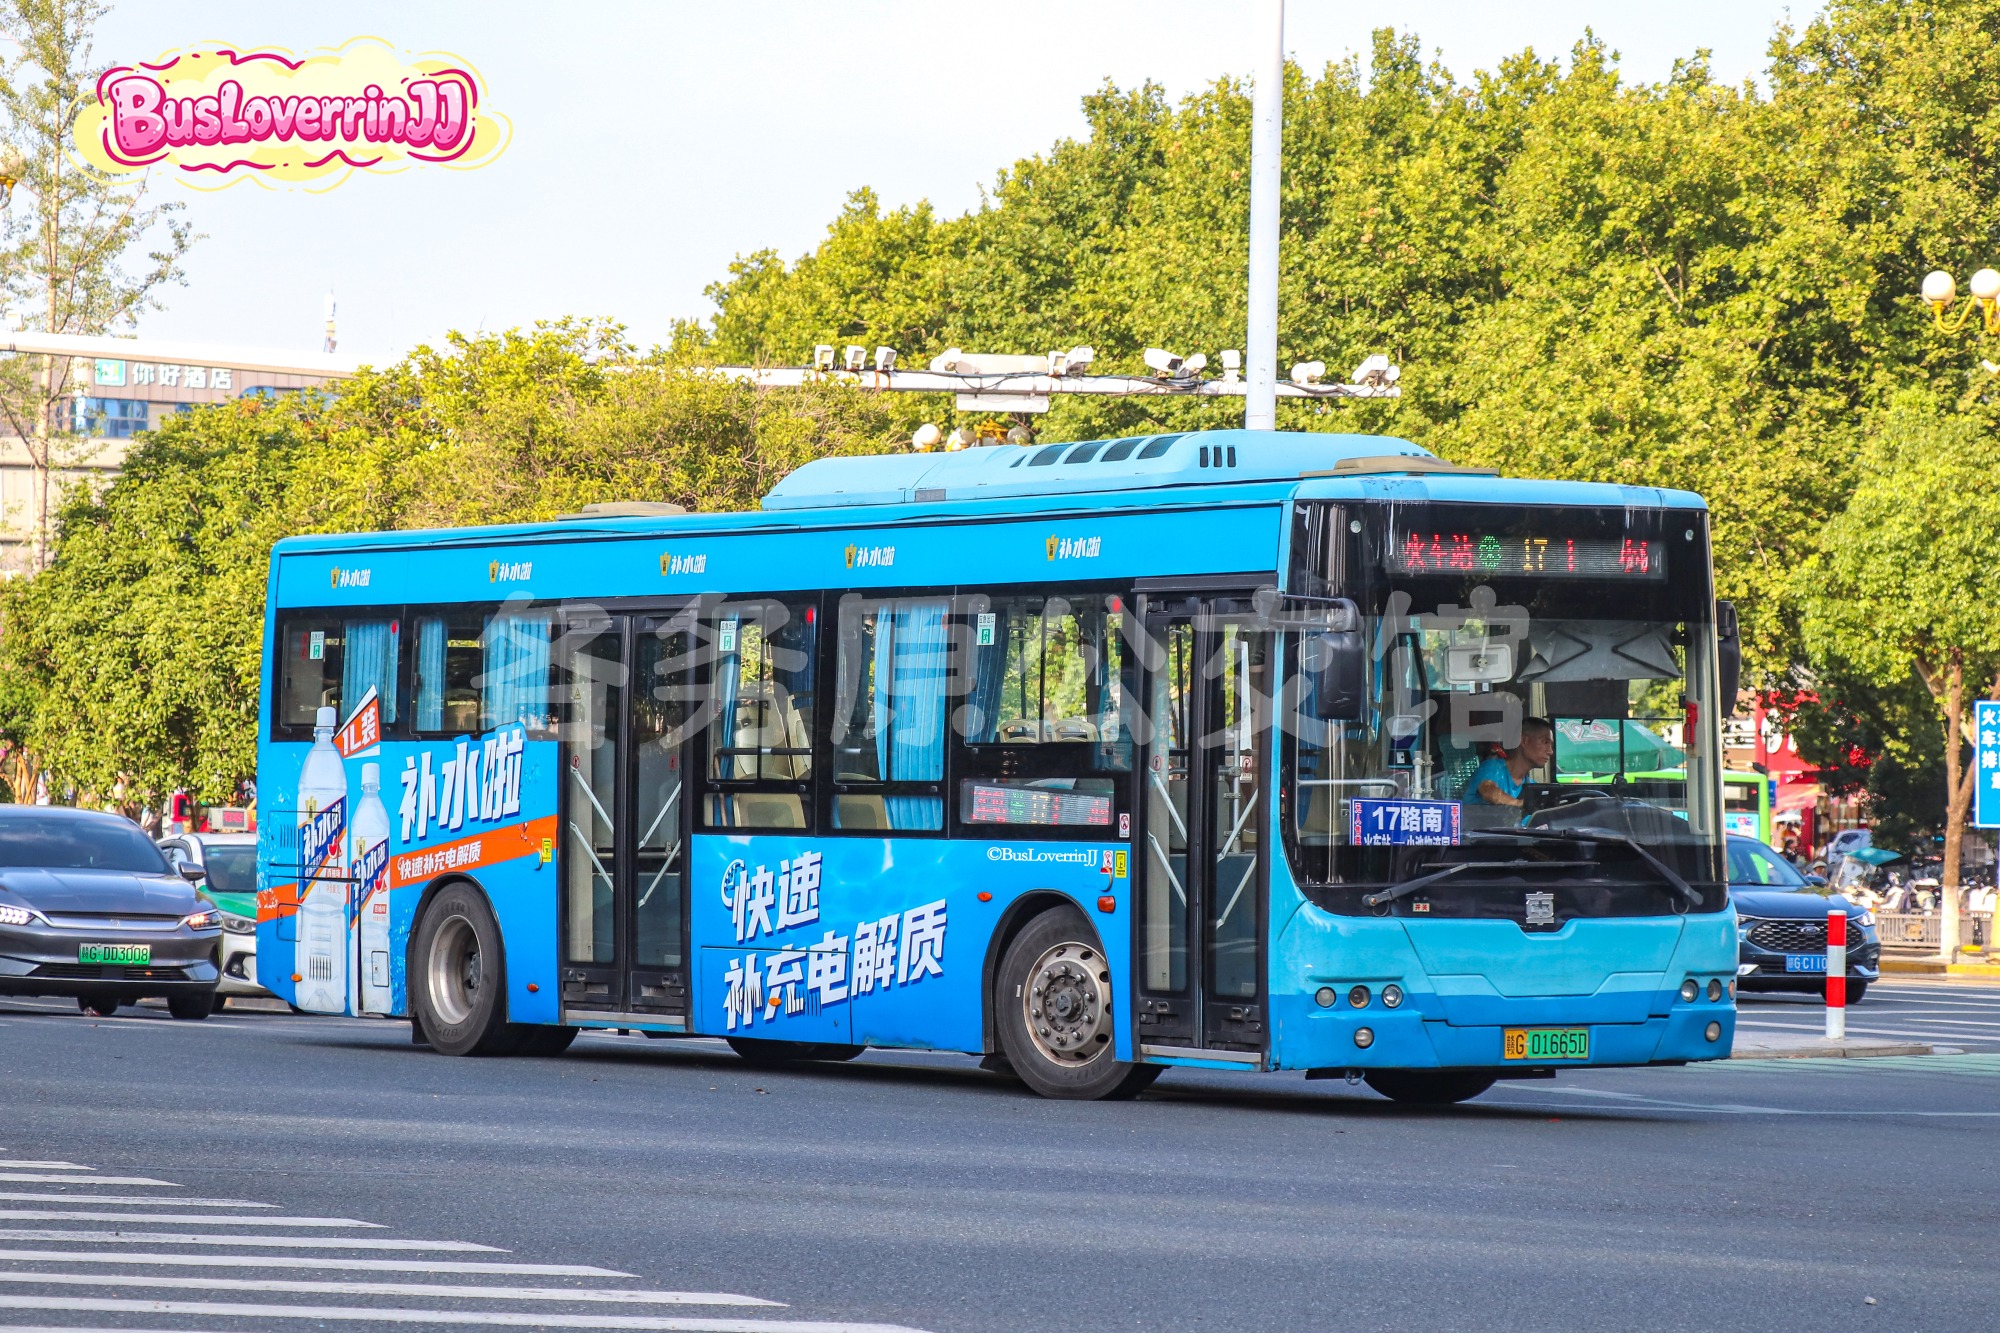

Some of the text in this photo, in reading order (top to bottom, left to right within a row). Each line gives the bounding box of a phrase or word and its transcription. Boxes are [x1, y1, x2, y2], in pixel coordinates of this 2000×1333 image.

[132, 363, 232, 390] 你好酒店
[856, 545, 895, 567] 补水啦
[1058, 536, 1101, 559] 补水啦
[1522, 538, 1549, 571] 17
[340, 568, 371, 587] 补水啦
[499, 561, 533, 582] 补水啦
[670, 554, 707, 575] 补水啦
[1981, 708, 2000, 726] 火
[342, 706, 376, 756] 1L装
[1981, 729, 2000, 748] 车
[398, 728, 524, 843] 补水啦
[1372, 806, 1442, 833] 17路南
[399, 841, 481, 880] 快速补充电解质
[731, 850, 822, 942] 快速
[723, 899, 947, 1030] 补充电解质
